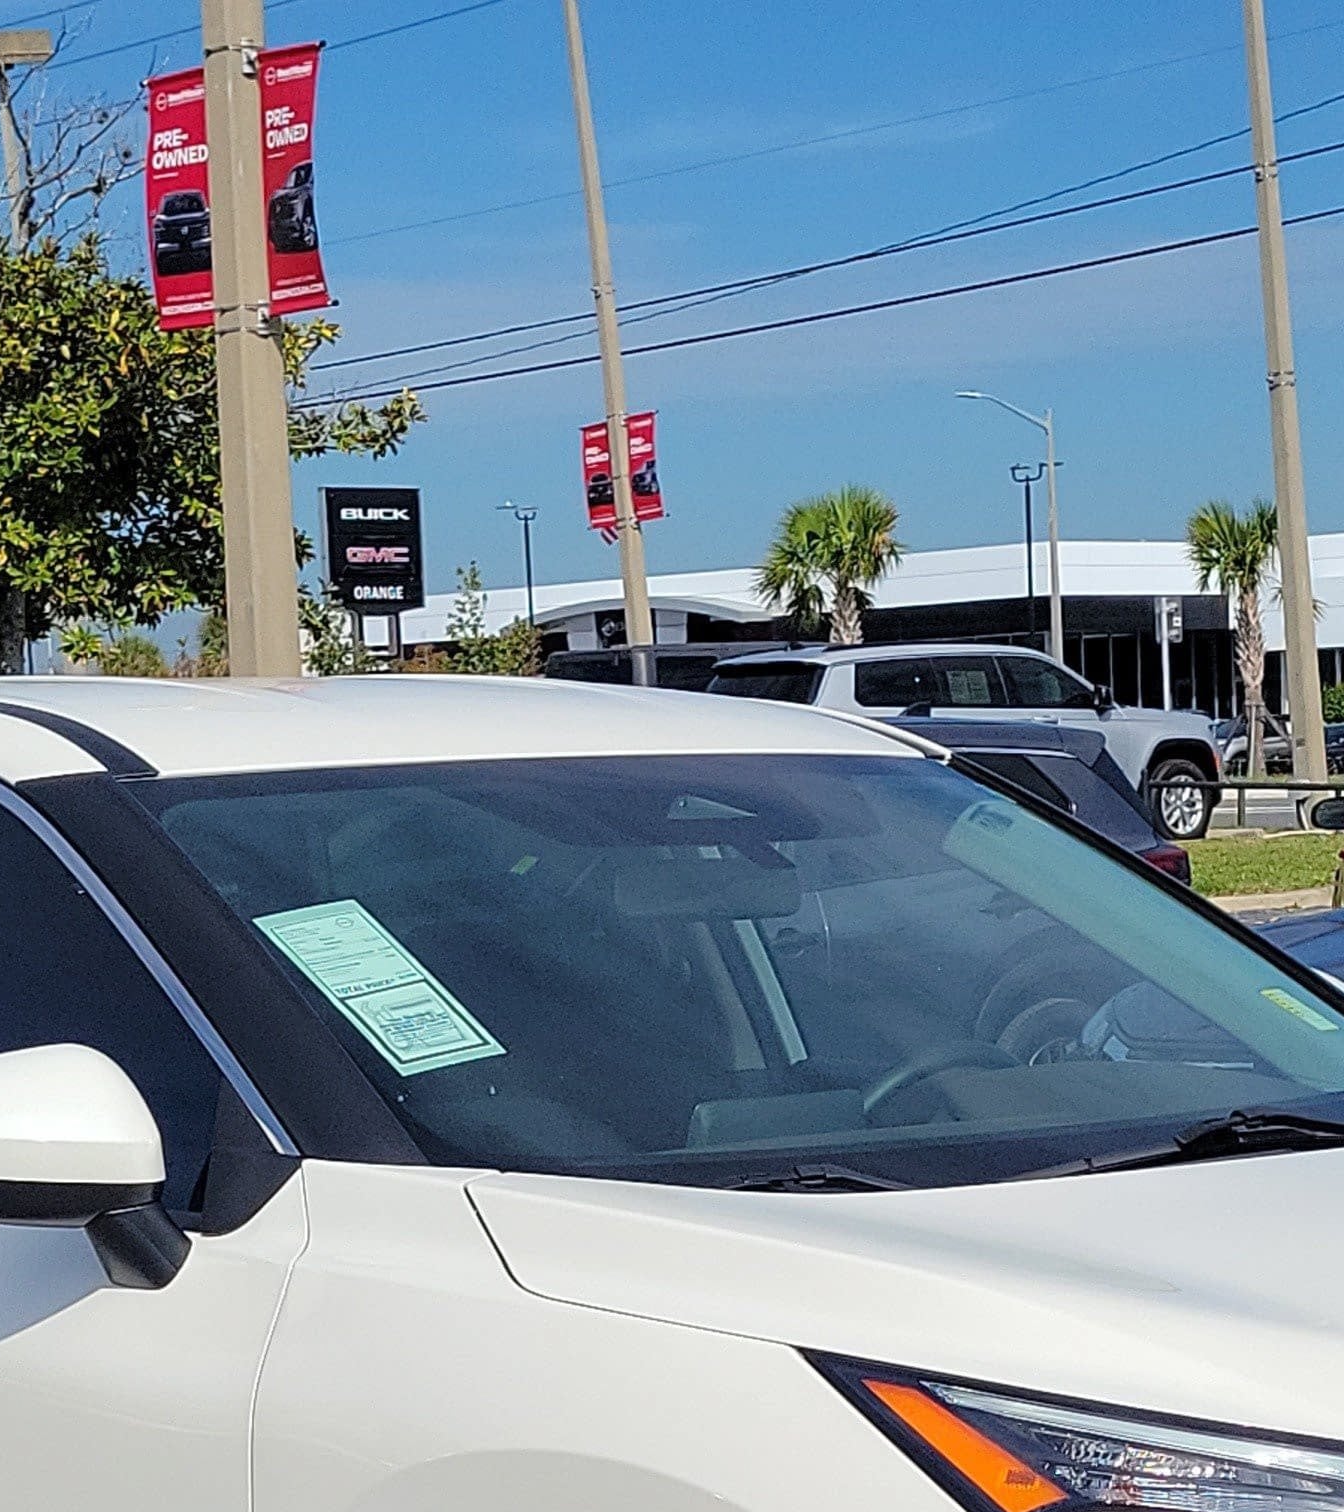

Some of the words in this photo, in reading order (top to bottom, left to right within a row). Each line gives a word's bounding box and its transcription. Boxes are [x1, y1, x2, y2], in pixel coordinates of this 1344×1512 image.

[265, 106, 295, 128] PRE-
[153, 128, 189, 150] PRE-
[265, 123, 308, 149] OWNED
[152, 144, 209, 169] OWNED
[340, 507, 410, 520] BUICK
[345, 546, 410, 563] GMC
[353, 585, 404, 600] ORANGE
